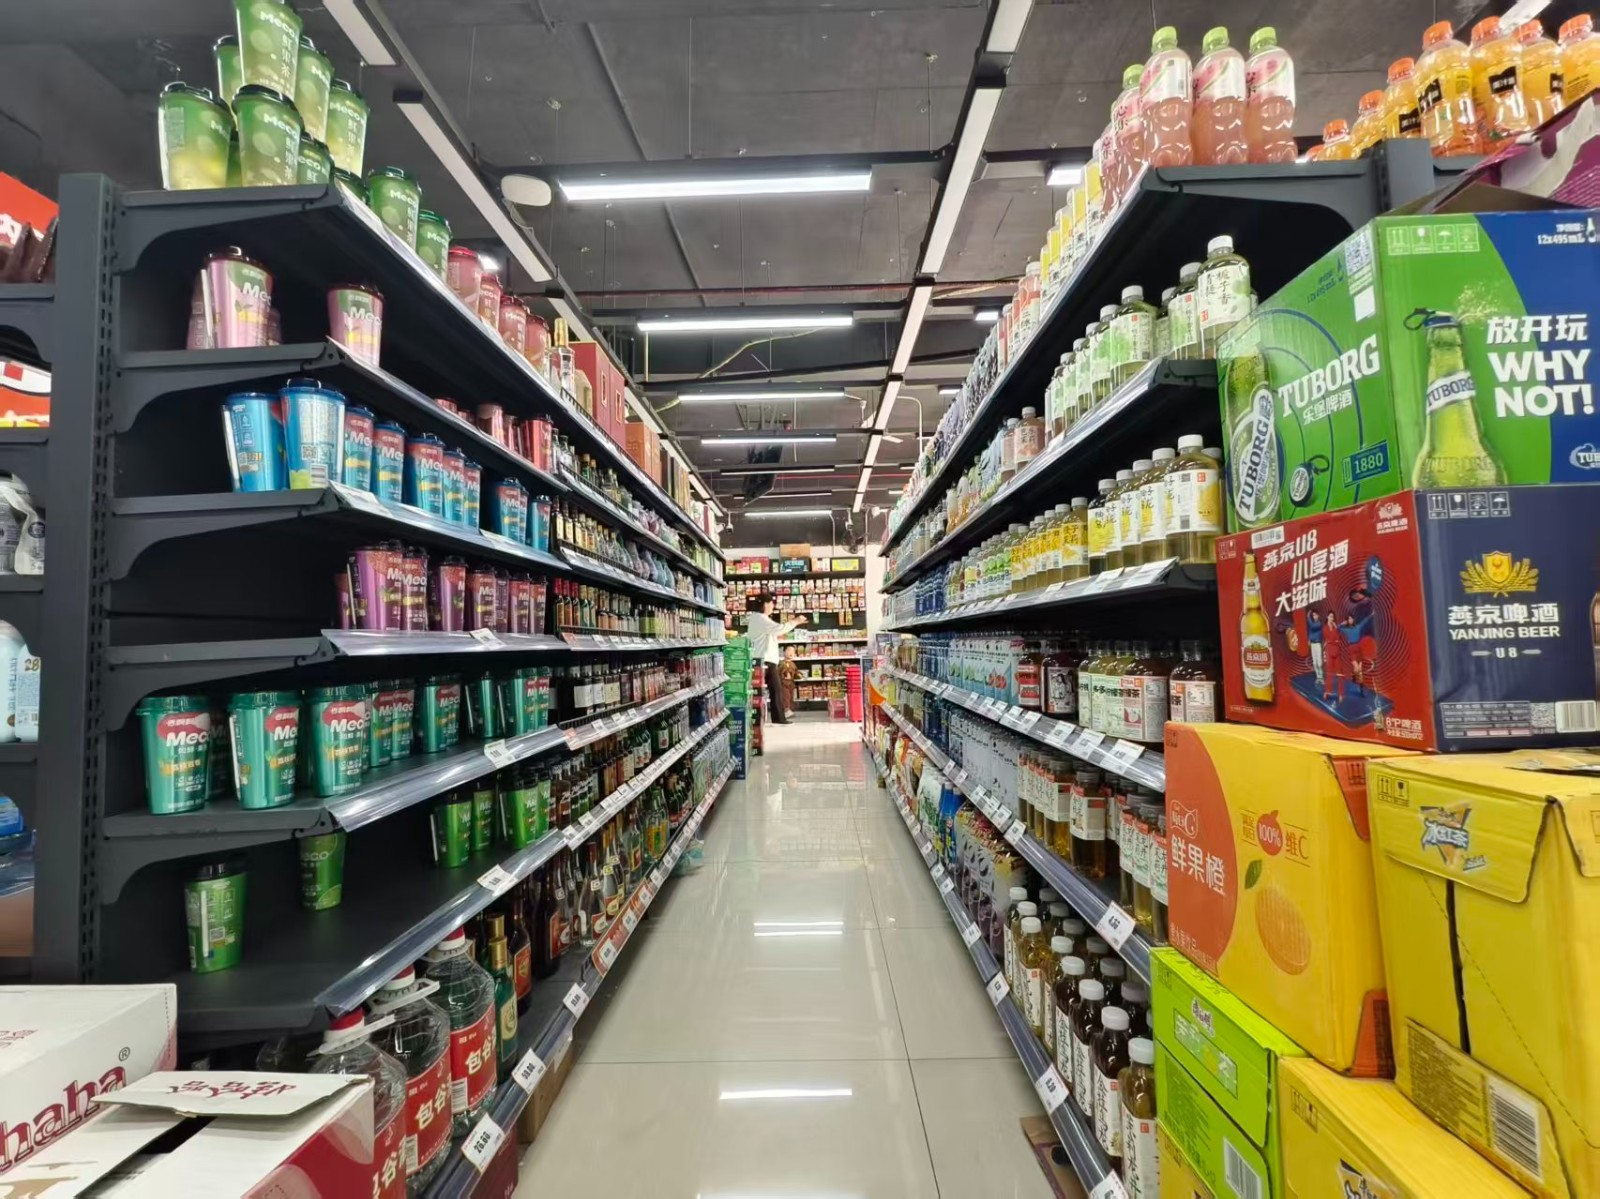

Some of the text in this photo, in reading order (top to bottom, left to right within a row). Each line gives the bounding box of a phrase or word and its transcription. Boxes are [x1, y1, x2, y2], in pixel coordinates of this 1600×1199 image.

[1487, 313, 1588, 345] 放开玩
[1277, 333, 1380, 418] TUBORG
[1487, 349, 1591, 383] WHY
[1494, 383, 1594, 418] NOT!
[1239, 419, 1269, 512] TUBORG
[1355, 452, 1384, 474] 1880
[1262, 529, 1317, 572] 燕京U8
[1292, 539, 1350, 586] 小度酒
[1275, 577, 1328, 617] 大滋味
[1448, 603, 1560, 626] 燕京啤酒
[1449, 626, 1561, 641] YANJING BEER
[1258, 823, 1281, 848] 100%
[1285, 830, 1310, 860] 维C
[1422, 819, 1470, 849] 冰红茶
[1171, 833, 1225, 897] 鲜果橙
